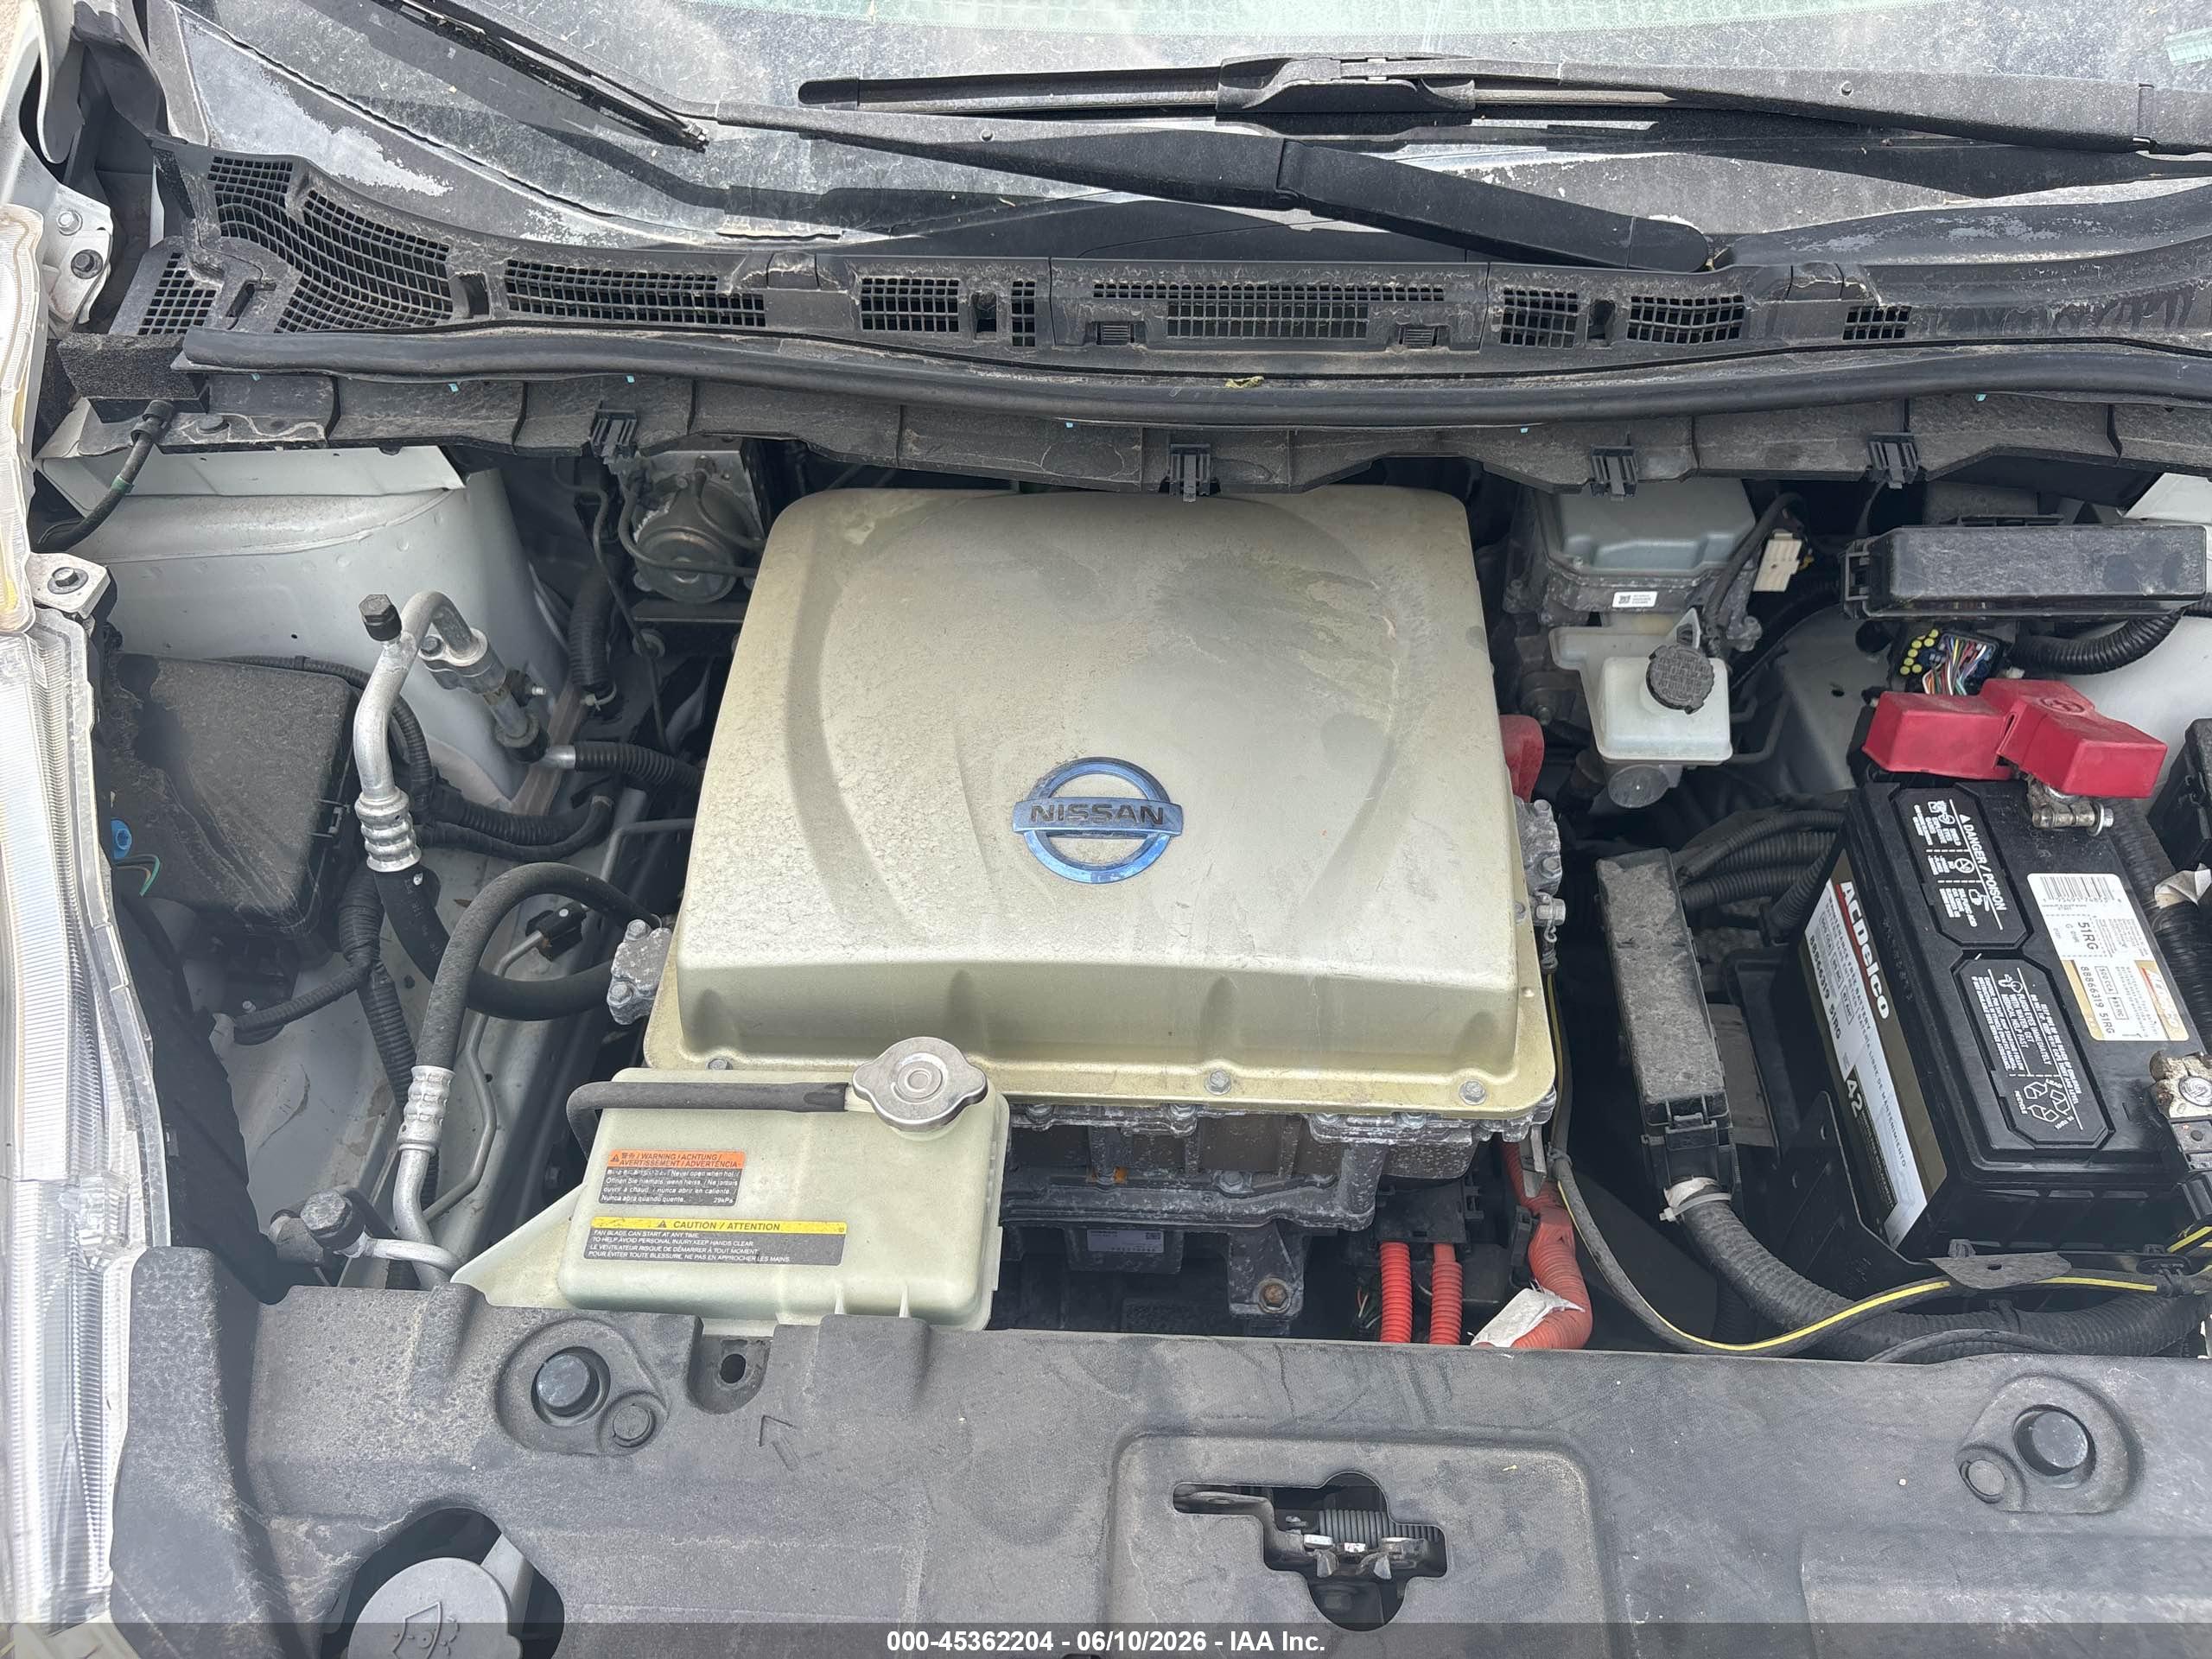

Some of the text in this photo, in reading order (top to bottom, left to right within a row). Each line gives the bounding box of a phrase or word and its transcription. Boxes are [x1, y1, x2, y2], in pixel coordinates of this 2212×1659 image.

[1031, 804, 1165, 825] NISSAN
[1963, 824, 1986, 862] DANGER
[1982, 873, 2005, 910] POISON
[2077, 922, 2098, 949] 51RG
[1841, 882, 1888, 1017] ACDelco
[1809, 935, 1829, 998] 88866319
[1829, 1003, 1840, 1039] 51RG
[2081, 966, 2114, 1033] 88866319 51RG
[2104, 981, 2113, 991] CCA
[1855, 987, 1870, 1029] BATTERY
[2001, 994, 2015, 1017] MEDICAL
[2011, 1018, 2022, 1033] HELP
[2024, 1031, 2034, 1042] GET
[2016, 1033, 2028, 1047] FAST
[2031, 1027, 2051, 1065] IMMEDIATELY
[1847, 1079, 1862, 1116] 42
[673, 1220, 716, 1229] CAUTION
[727, 1222, 779, 1230] ATTENTION
